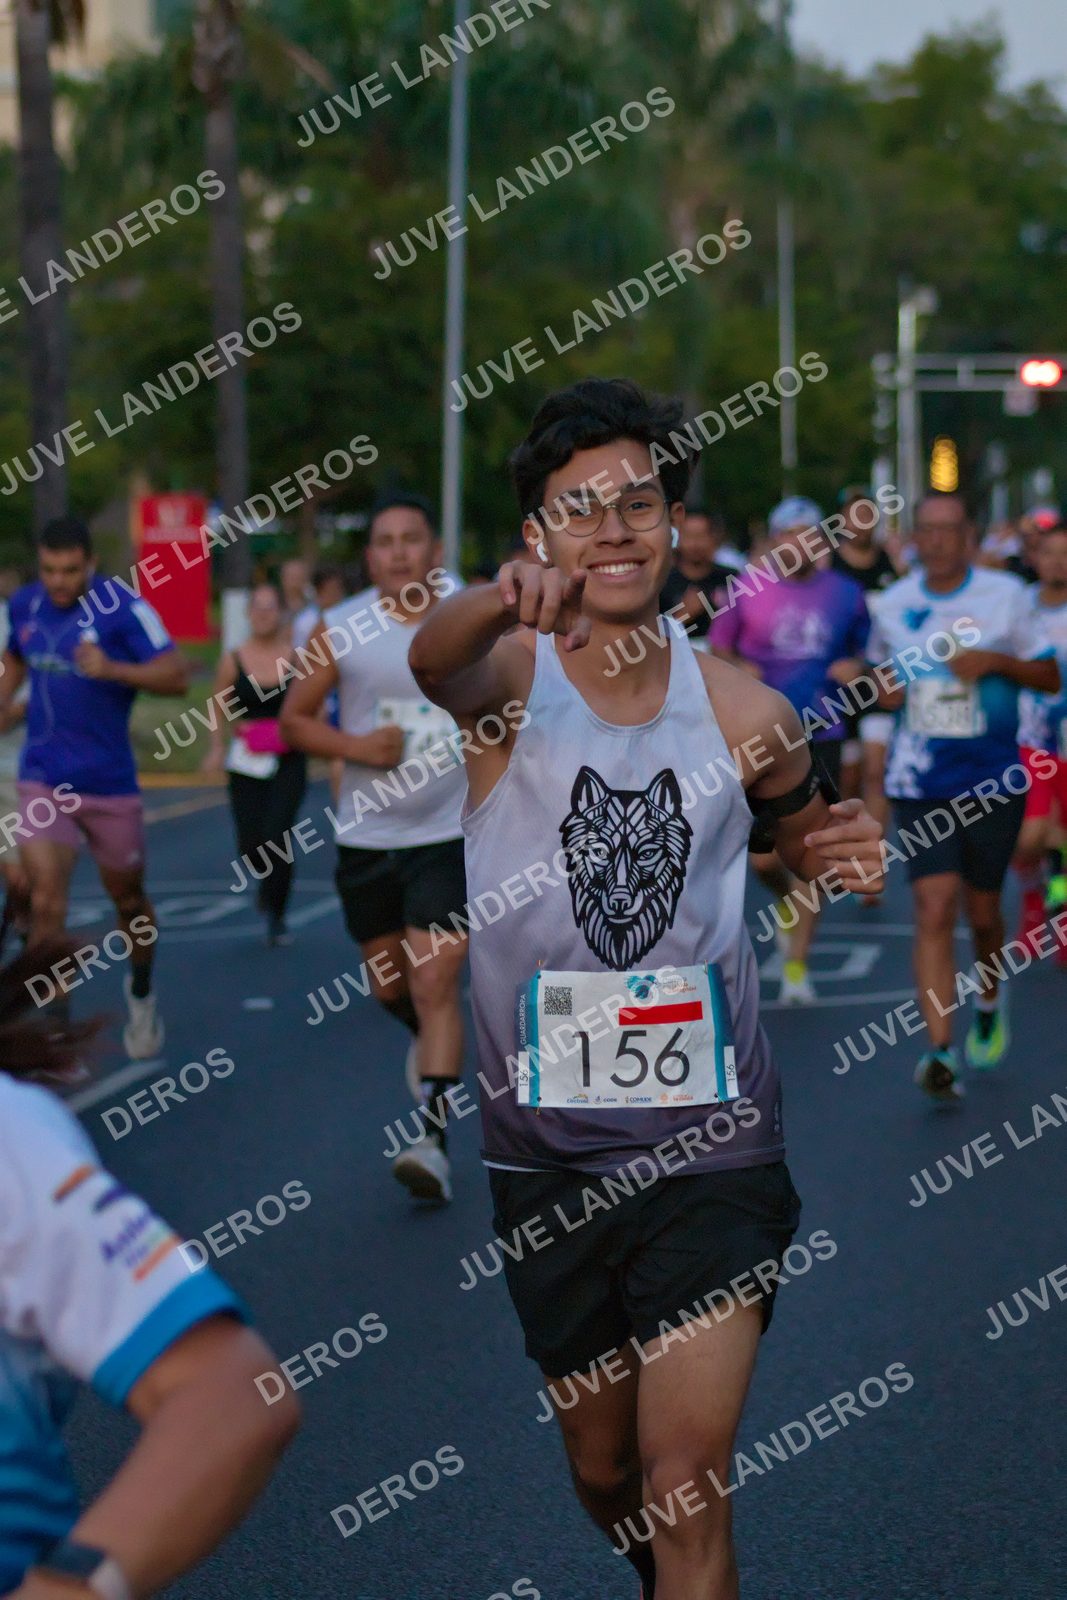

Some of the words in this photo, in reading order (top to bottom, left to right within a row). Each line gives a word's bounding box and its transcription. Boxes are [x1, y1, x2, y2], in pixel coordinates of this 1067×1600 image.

[519, 993, 527, 1045] GUARDARROPA
[572, 1027, 690, 1088] 156
[726, 1064, 736, 1081] 156
[519, 1069, 529, 1087] 156
